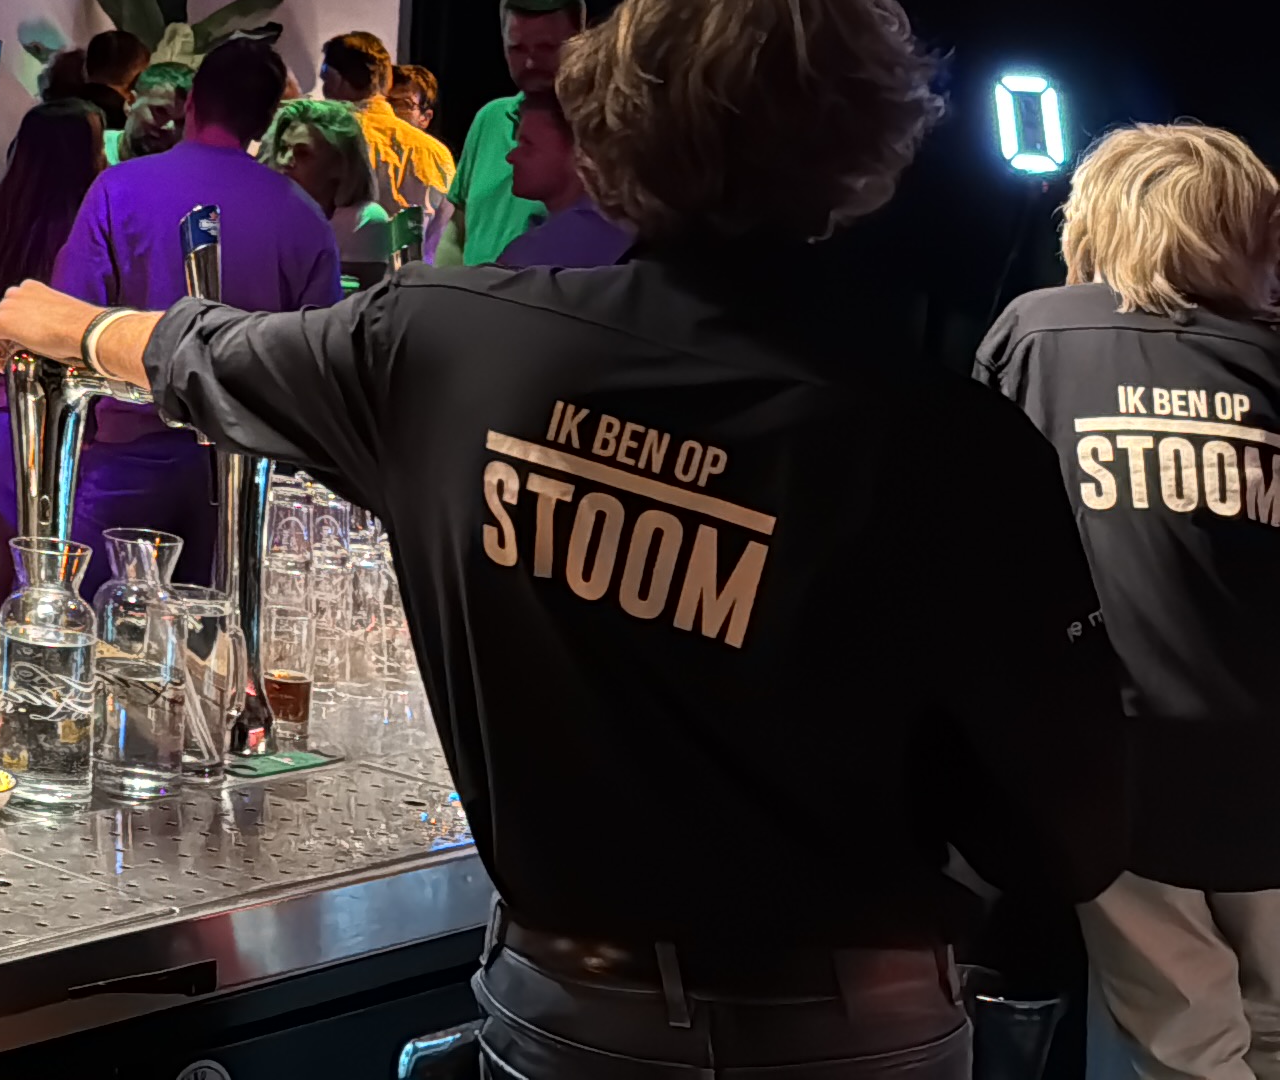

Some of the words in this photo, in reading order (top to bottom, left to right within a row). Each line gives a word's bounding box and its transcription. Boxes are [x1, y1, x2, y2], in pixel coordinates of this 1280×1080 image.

[546, 400, 590, 449] IK
[591, 414, 671, 474] BEN
[674, 439, 728, 488] OP
[1117, 385, 1147, 415] IK
[1151, 387, 1209, 419] BEN
[1214, 391, 1251, 422] OP
[1076, 433, 1280, 528] STOOM
[482, 460, 769, 649] STOOM
